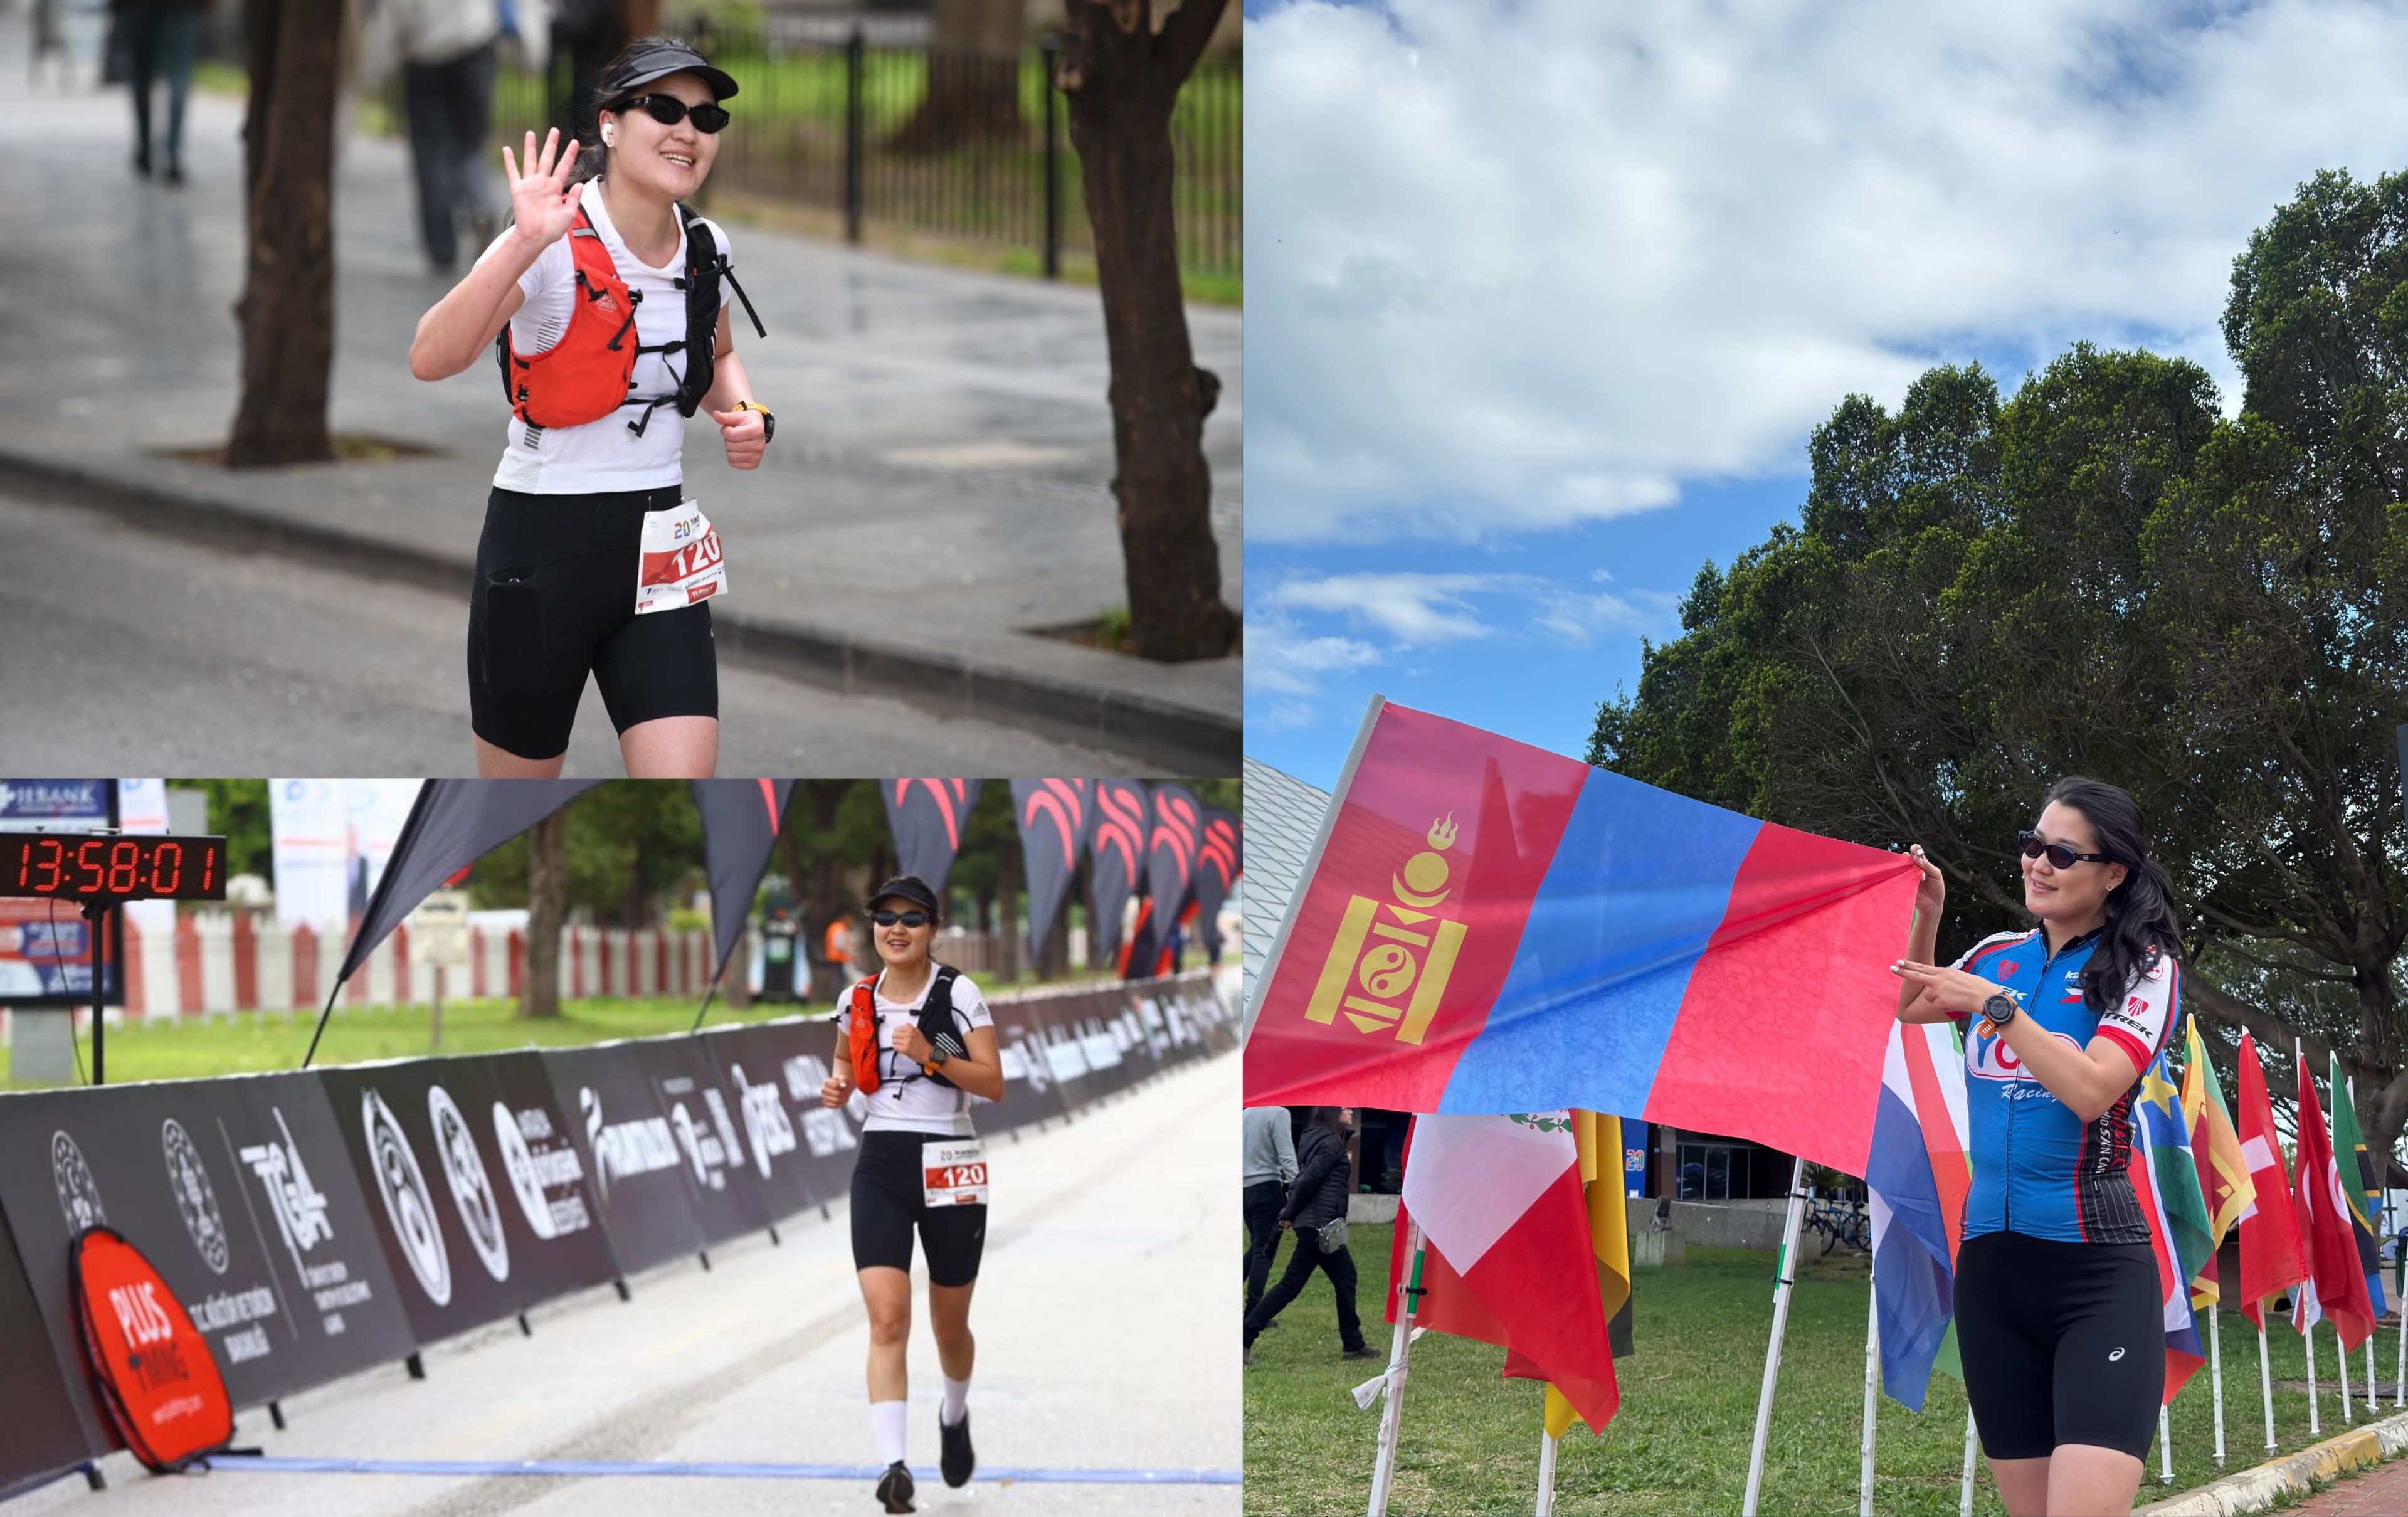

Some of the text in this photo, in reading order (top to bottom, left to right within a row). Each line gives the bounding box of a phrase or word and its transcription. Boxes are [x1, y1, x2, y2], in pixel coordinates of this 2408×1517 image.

[674, 519, 691, 540] 20
[672, 531, 721, 577] 120
[19, 840, 214, 894] 13:58:01
[2104, 1012, 2153, 1040] TREK
[1626, 1148, 1645, 1171] 20
[943, 1165, 985, 1187] 120
[108, 1281, 173, 1350] PLUS
